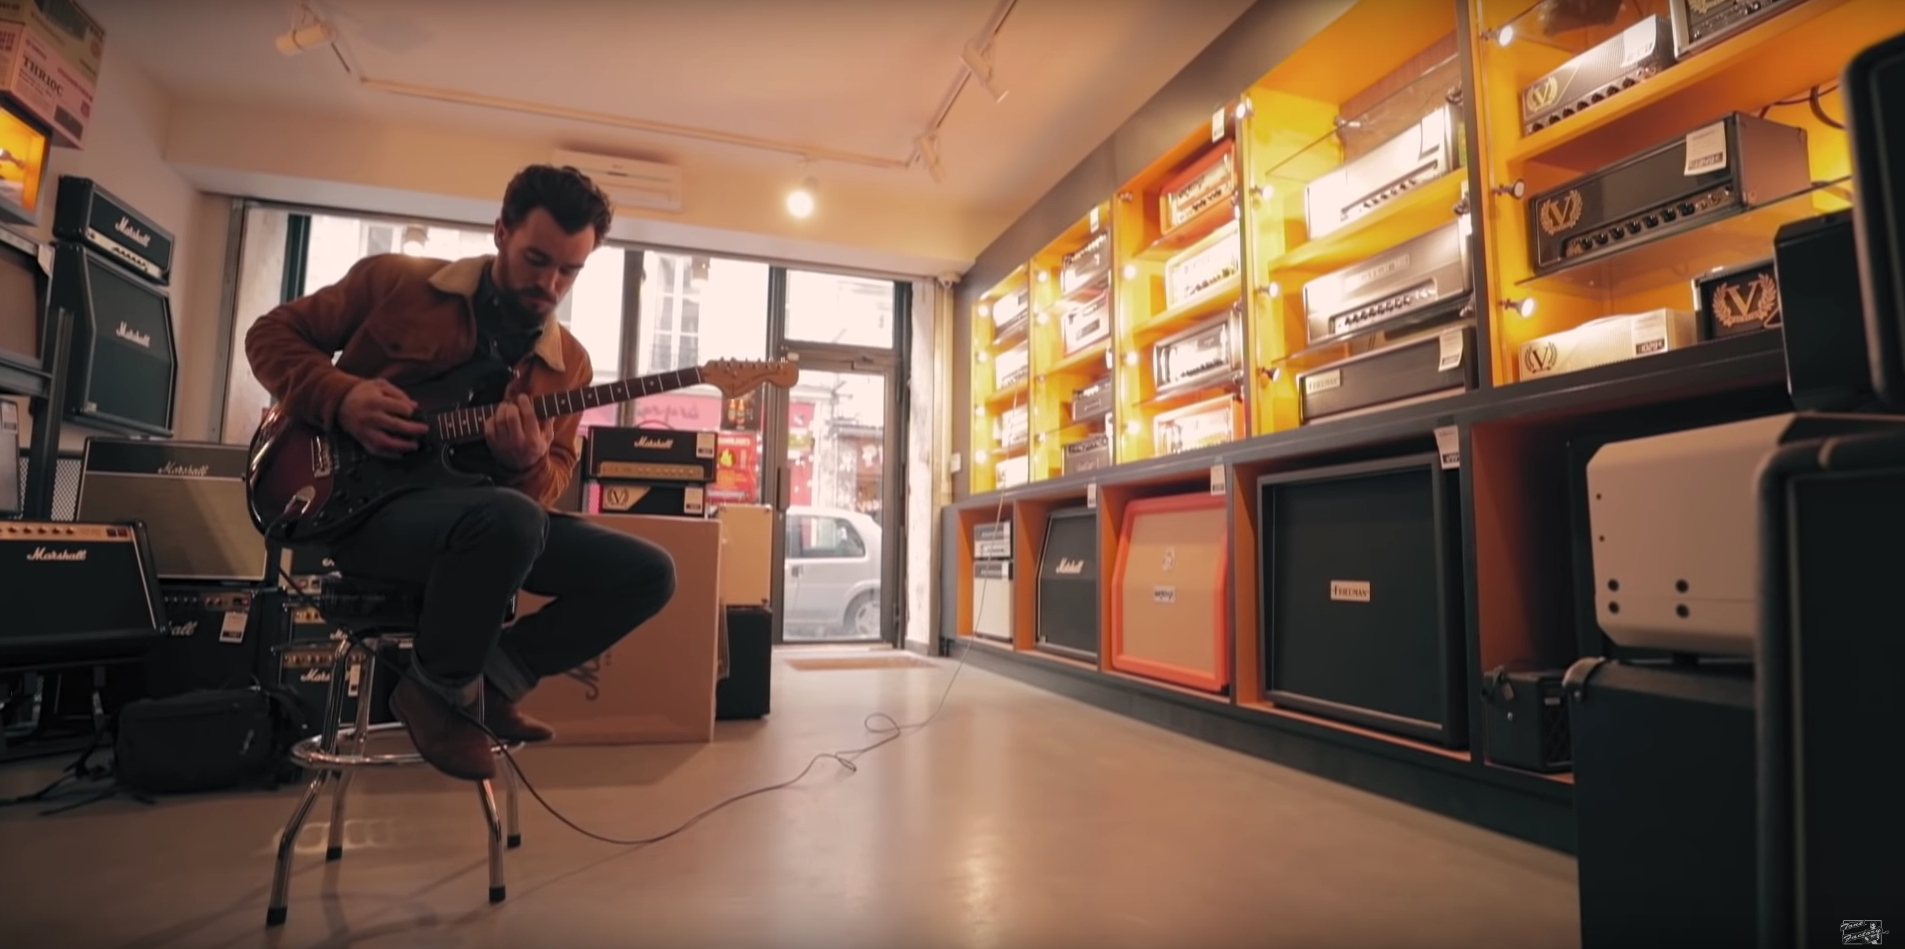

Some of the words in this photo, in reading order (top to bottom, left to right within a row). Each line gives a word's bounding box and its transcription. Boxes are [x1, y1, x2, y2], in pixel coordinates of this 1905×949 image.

[115, 216, 151, 248] Marshall
[116, 321, 150, 348] Marshall
[634, 435, 674, 449] Marshall
[158, 461, 209, 476] Marshall
[26, 547, 87, 561] Marshall
